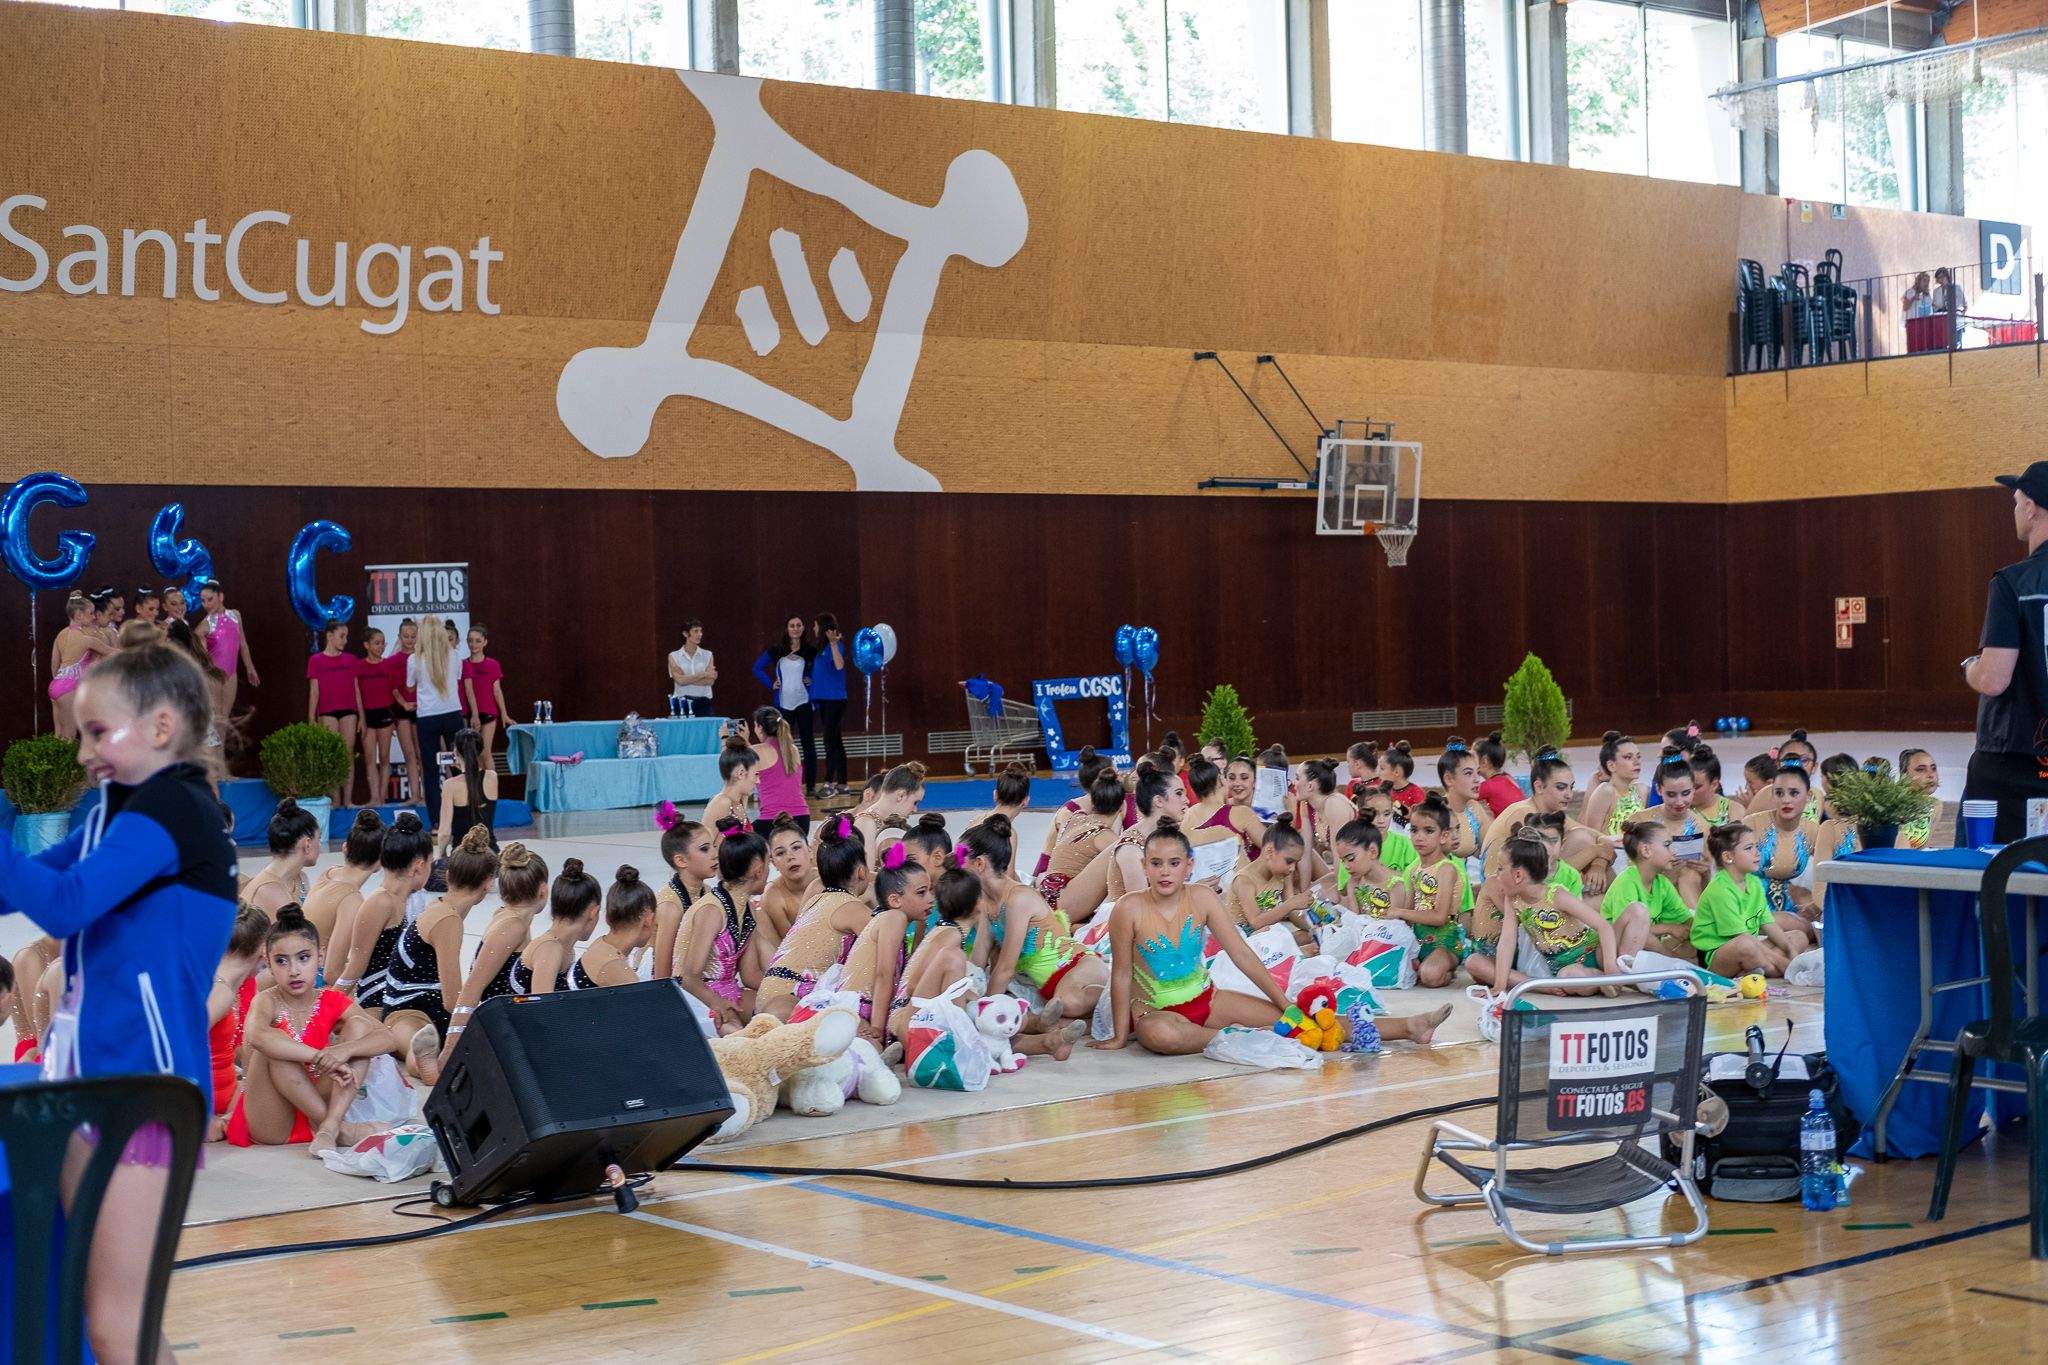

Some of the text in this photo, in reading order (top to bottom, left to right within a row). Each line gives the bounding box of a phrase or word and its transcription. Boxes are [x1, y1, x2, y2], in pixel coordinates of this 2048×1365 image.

[0, 194, 504, 335] SantCugat
[1990, 233, 2015, 280] D
[0, 471, 96, 589] G
[287, 519, 356, 629] C
[370, 570, 464, 604] TTFOTOS
[371, 604, 413, 613] DEPORTES
[425, 602, 465, 611] SESIONES
[1045, 683, 1077, 696] Trofeu
[1079, 676, 1122, 697] CGSC
[1560, 1028, 1649, 1064] TTFOTOS
